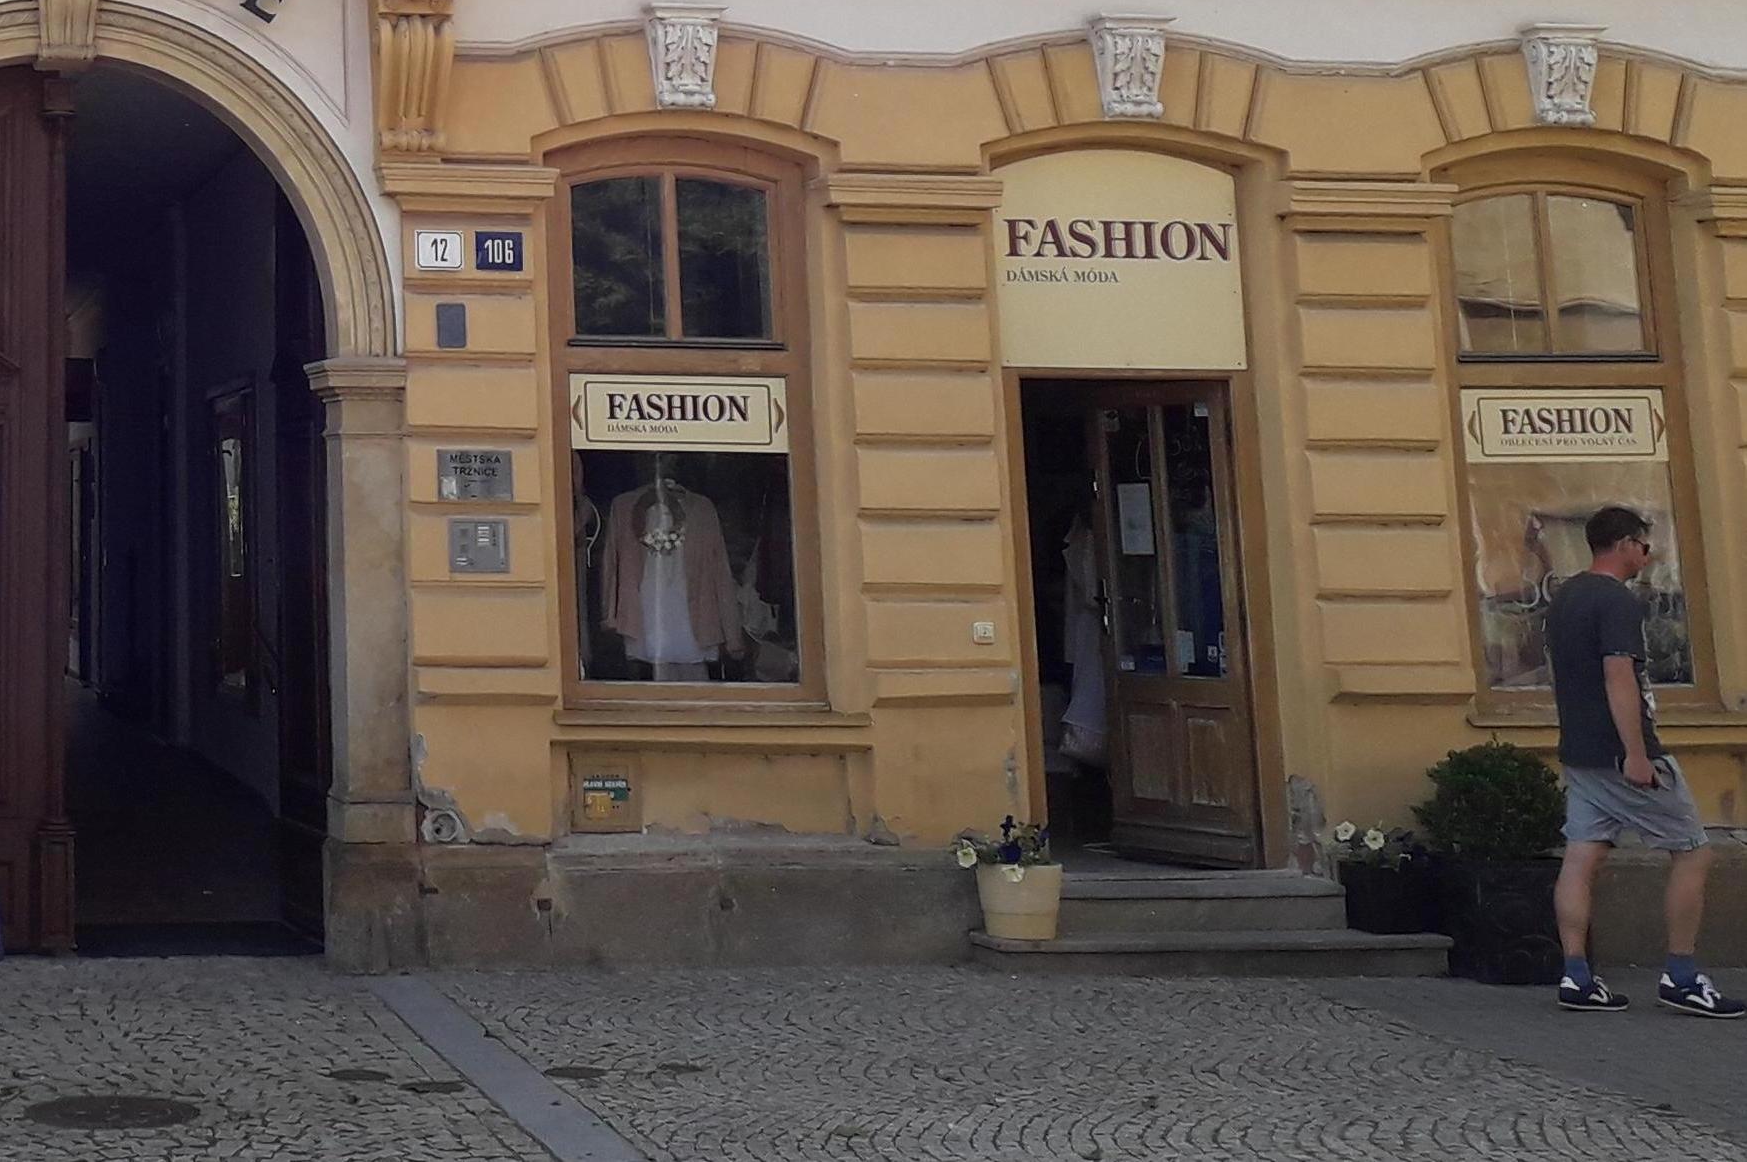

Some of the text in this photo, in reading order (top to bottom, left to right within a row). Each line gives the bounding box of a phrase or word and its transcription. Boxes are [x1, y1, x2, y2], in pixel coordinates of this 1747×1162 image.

[430, 238, 449, 262] 12
[484, 239, 515, 264] 106
[1003, 217, 1233, 261] FASHION
[1006, 266, 1120, 284] DÁMSKÁ MÓDA
[606, 393, 750, 422] FASHION
[1500, 407, 1634, 435] FASHION
